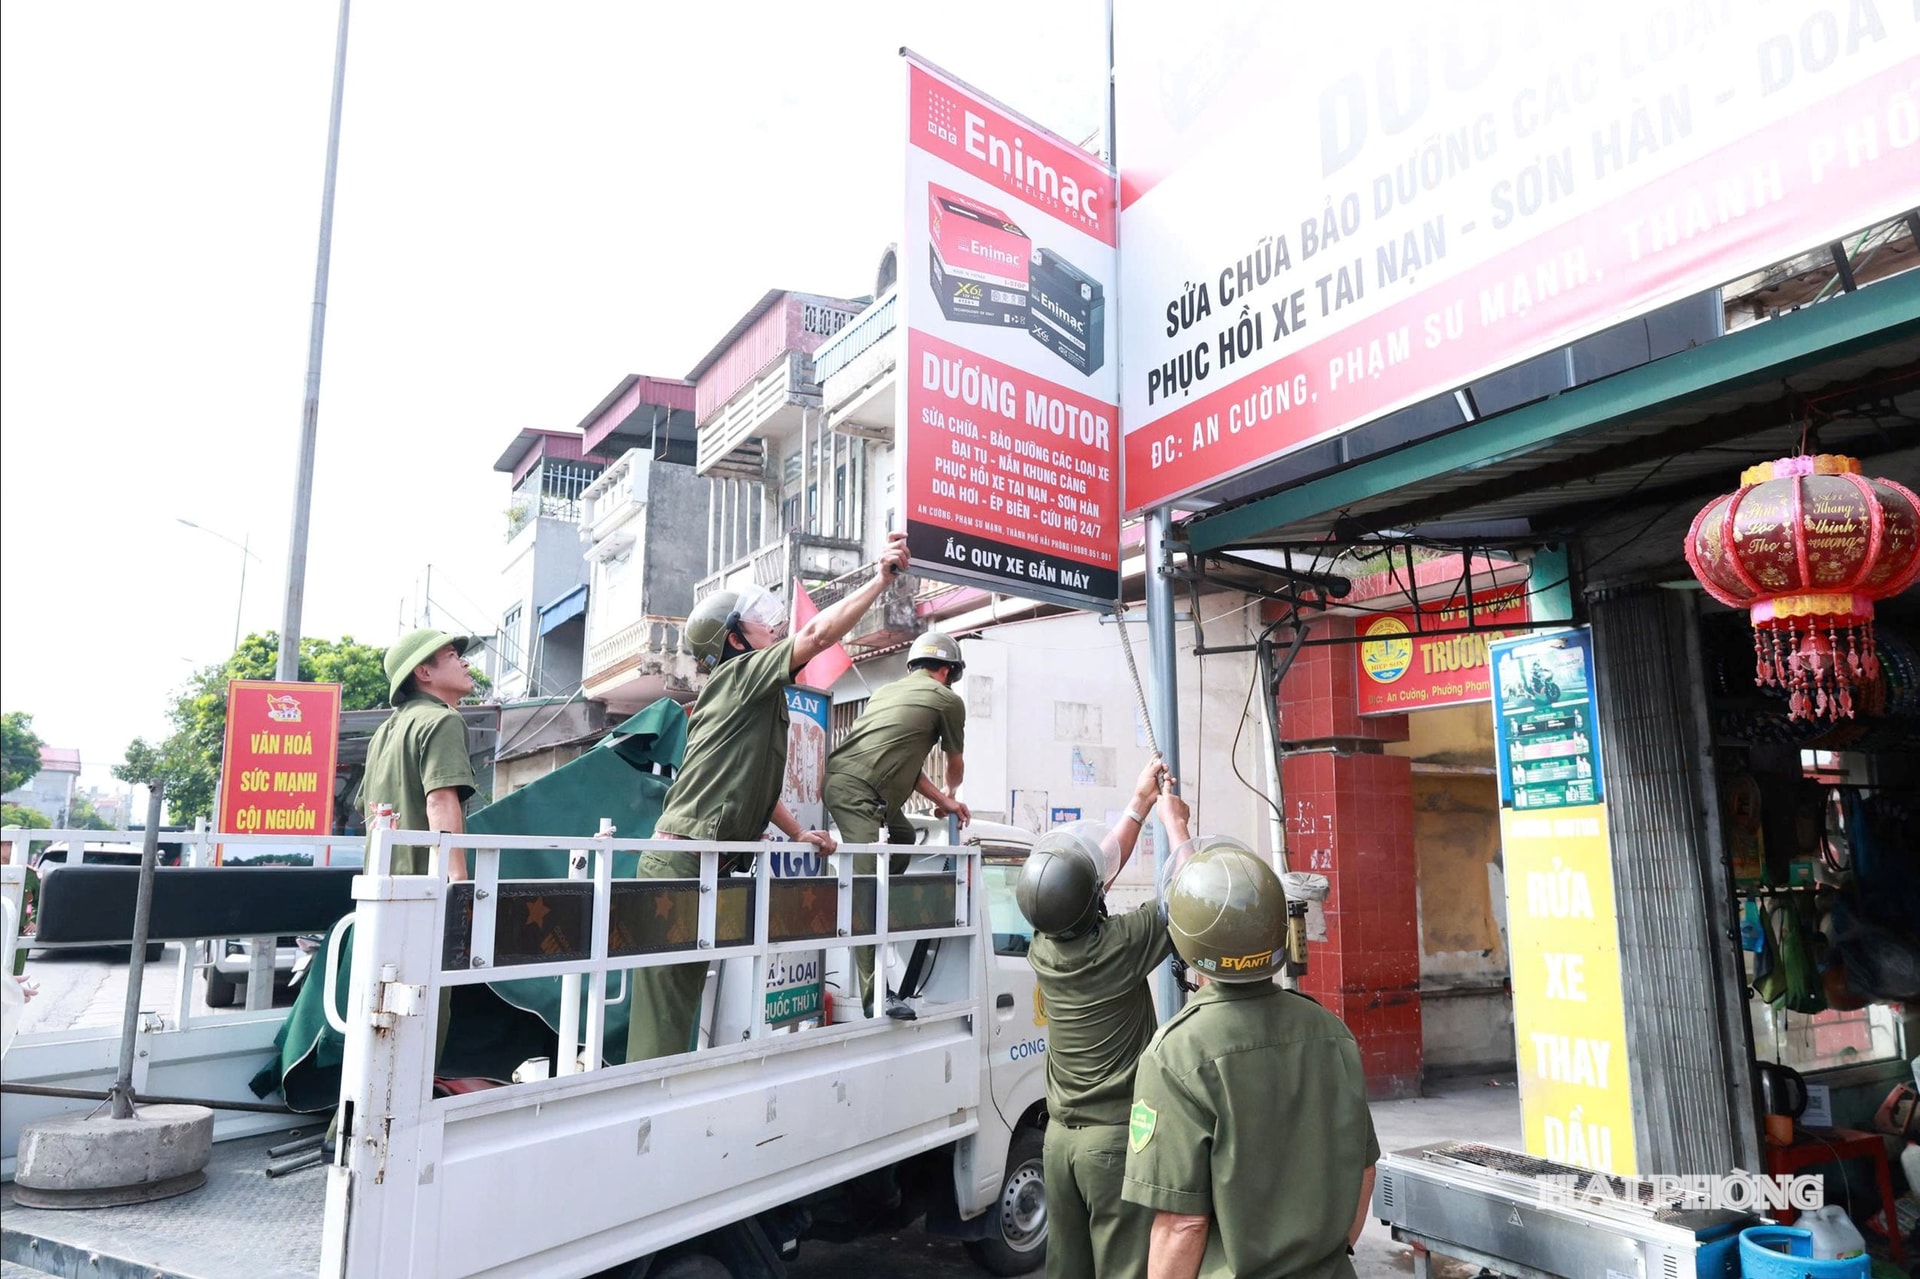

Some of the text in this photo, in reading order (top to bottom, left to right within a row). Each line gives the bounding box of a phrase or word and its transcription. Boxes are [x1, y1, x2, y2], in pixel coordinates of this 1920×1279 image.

[964, 109, 1099, 221] Enimac
[1003, 173, 1060, 208] TIMELESS
[1064, 206, 1101, 230] POWER
[1147, 350, 1212, 406] PHỤC
[1218, 304, 1265, 370] HỒI
[1272, 286, 1309, 342] XE
[1315, 264, 1364, 318] TAI
[1376, 216, 1449, 284] NẠN
[1490, 156, 1576, 230] SƠN
[1592, 84, 1692, 180] HÀN
[1758, 0, 1888, 98] DOA
[1165, 282, 1212, 338] SỬA
[1218, 232, 1292, 307] CHỮA
[1300, 196, 1362, 268] BẢO
[1372, 120, 1498, 216] DƯỠNG
[970, 239, 1021, 266] Enimac
[1040, 291, 1085, 335] Enimac
[1150, 434, 1184, 470] ĐC:
[1191, 418, 1221, 452] AN
[1228, 372, 1319, 438] CƯỜNG,
[1329, 324, 1410, 392] PHẠM
[1477, 242, 1604, 328] MẠNH,
[922, 351, 1110, 452] DƯƠNG MOTOR
[922, 406, 944, 429] SỬA
[949, 417, 978, 440] CHỮA
[990, 429, 1011, 450] BẢO
[1015, 440, 1049, 463] DƯỠNG
[1052, 451, 1072, 470] CÁC
[1075, 459, 1096, 479] LOẠI
[1098, 466, 1109, 482] XE
[952, 439, 970, 458] ĐẠI
[974, 447, 987, 464] TU
[999, 453, 1019, 474] NẮN
[1023, 463, 1056, 486] KHUNG
[1060, 472, 1086, 494] CÀNG
[932, 478, 955, 499] DOA
[959, 486, 978, 505] HƠI
[990, 491, 1003, 511] ÉP
[1006, 499, 1030, 519] BIÊN
[1040, 506, 1061, 528] CỨU
[1064, 518, 1078, 534] HỘ
[1080, 521, 1101, 539] 24/7
[935, 456, 966, 480] PHỤC
[970, 465, 989, 486] HỒI
[992, 474, 1005, 491] XE
[1008, 478, 1024, 496] TAI
[1027, 486, 1047, 504] NẠN
[1058, 494, 1076, 512] SƠN
[1080, 500, 1099, 518] HÀN
[945, 537, 1090, 590] ẮC QUY XE GẮN MÁY
[1459, 606, 1482, 618] BN
[251, 730, 312, 755] VĂN HOÁ
[240, 767, 317, 796] SỨC MẠNH
[236, 803, 315, 834] CỘI NGUỒN
[1526, 856, 1594, 919] RỬA
[766, 961, 816, 988] ÁC LOẠI
[1543, 953, 1588, 1002] XE
[765, 990, 818, 1019] HUỐC THÚ Y
[1530, 1032, 1611, 1089] THAY
